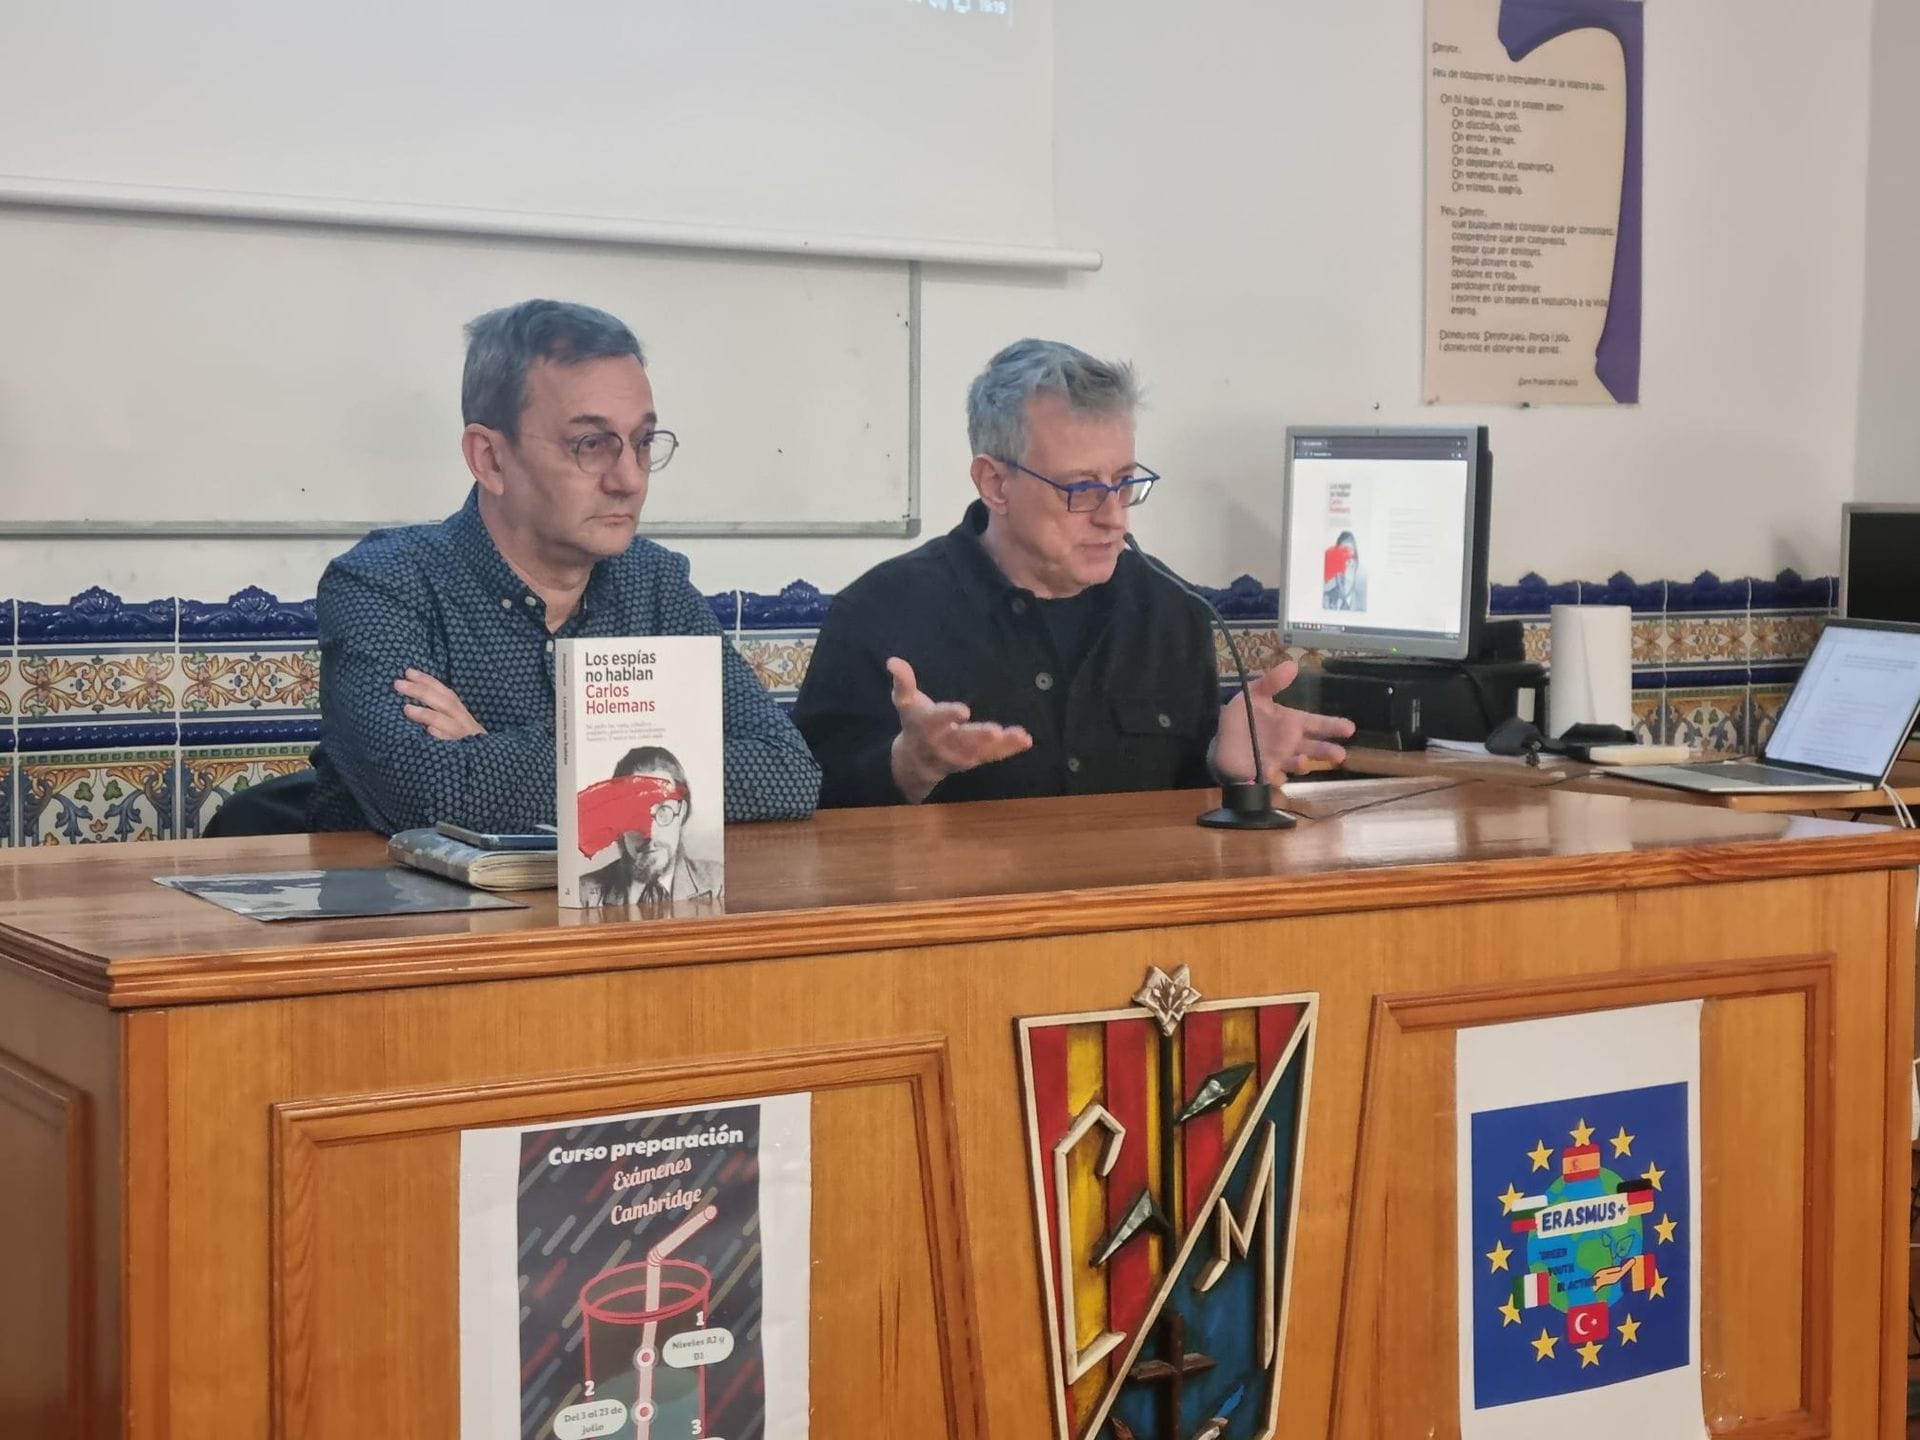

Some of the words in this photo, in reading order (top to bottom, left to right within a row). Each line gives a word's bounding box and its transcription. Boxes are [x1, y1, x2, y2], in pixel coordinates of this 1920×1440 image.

[586, 652, 609, 666] Los
[612, 650, 656, 668] espías
[586, 670, 602, 682] no
[606, 667, 654, 682] hablan
[586, 683, 630, 698] Carlos
[586, 699, 656, 715] Holemans
[548, 1146, 608, 1166] Curso
[610, 1124, 744, 1162] preparación
[612, 1157, 692, 1192] Exámenes
[611, 1188, 702, 1225] Cambridge
[1542, 1202, 1626, 1232] ERASMUS+
[696, 1311, 704, 1326] 1
[584, 1380, 596, 1397] 2
[564, 1412, 580, 1423] Del
[588, 1408, 598, 1420] al
[599, 1407, 610, 1418] 23
[611, 1406, 623, 1416] de
[582, 1423, 605, 1435] julio
[691, 1418, 702, 1435] 3
